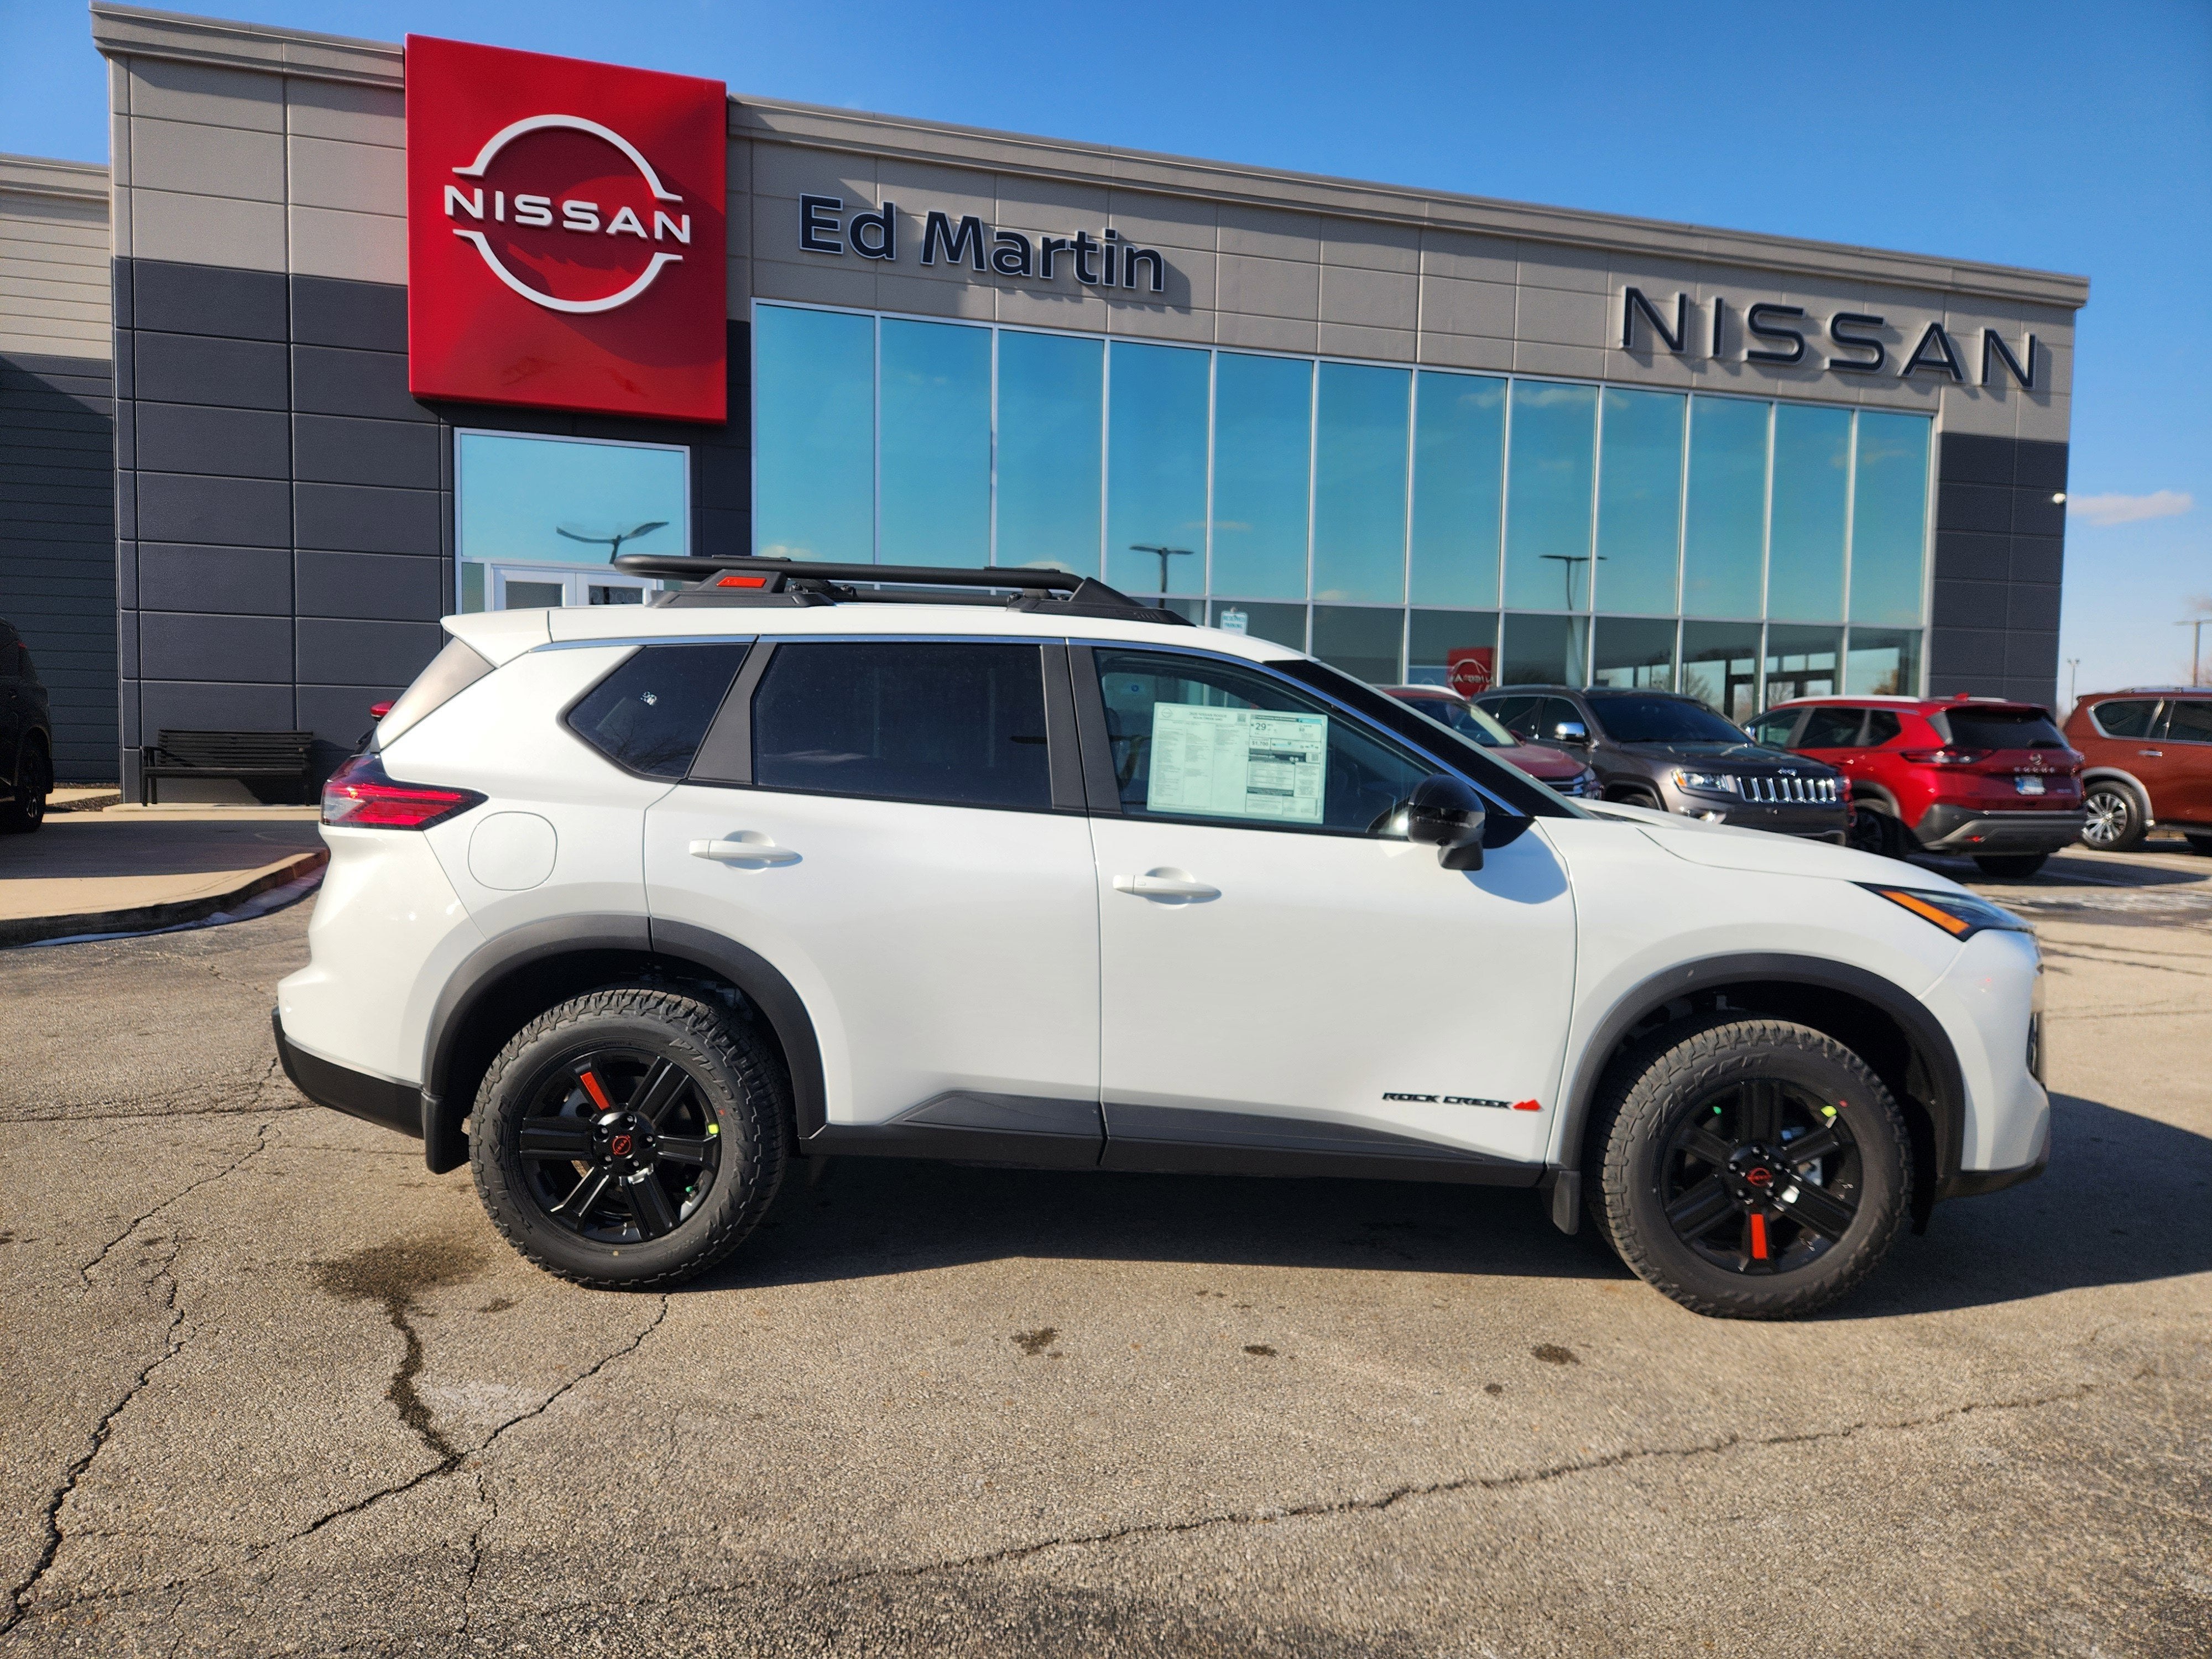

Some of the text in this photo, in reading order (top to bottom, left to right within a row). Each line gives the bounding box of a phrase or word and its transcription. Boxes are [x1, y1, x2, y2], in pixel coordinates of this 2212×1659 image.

[444, 185, 691, 244] NISSAN
[799, 193, 1164, 292] Ed Martin
[1618, 285, 2037, 390] NISSAN
[1383, 1092, 1513, 1110] ROCK CREEK
